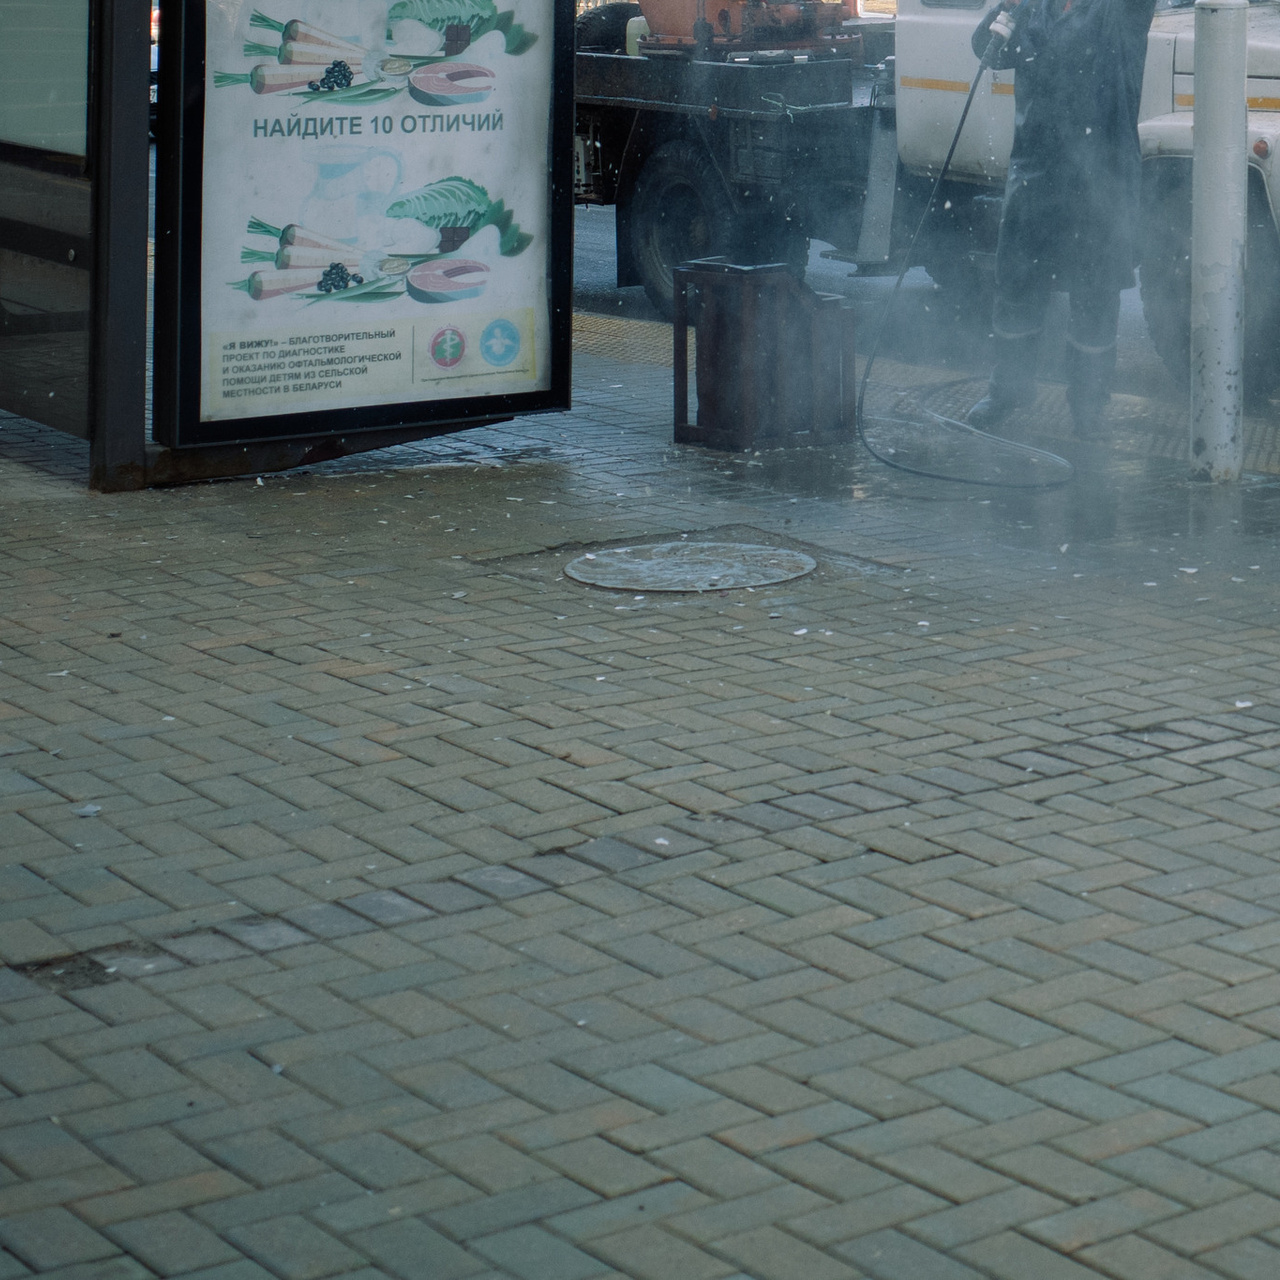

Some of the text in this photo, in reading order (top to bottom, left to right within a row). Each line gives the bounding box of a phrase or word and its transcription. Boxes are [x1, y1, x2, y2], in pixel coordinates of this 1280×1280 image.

[252, 109, 504, 139] НАЙДИТЕ 10 ОТЛИЧИЙ
[288, 327, 396, 346] БЛАГОТВОРИТЕЛЬНЫЙ
[222, 345, 346, 363] ПРОЕКТ ПО ДИАГНОСТИКЕ
[222, 351, 402, 375] И ОКАЗАНИЮ ОФТАЛЬМОЛОГИЧЕСКОЙ
[222, 365, 368, 387] ПОМОЩИ ДЕТЯМ ИЗ СЕЛЬСКОЙ
[222, 380, 342, 399] МЕСТНОСТИ В БЕЛАРУСИ
